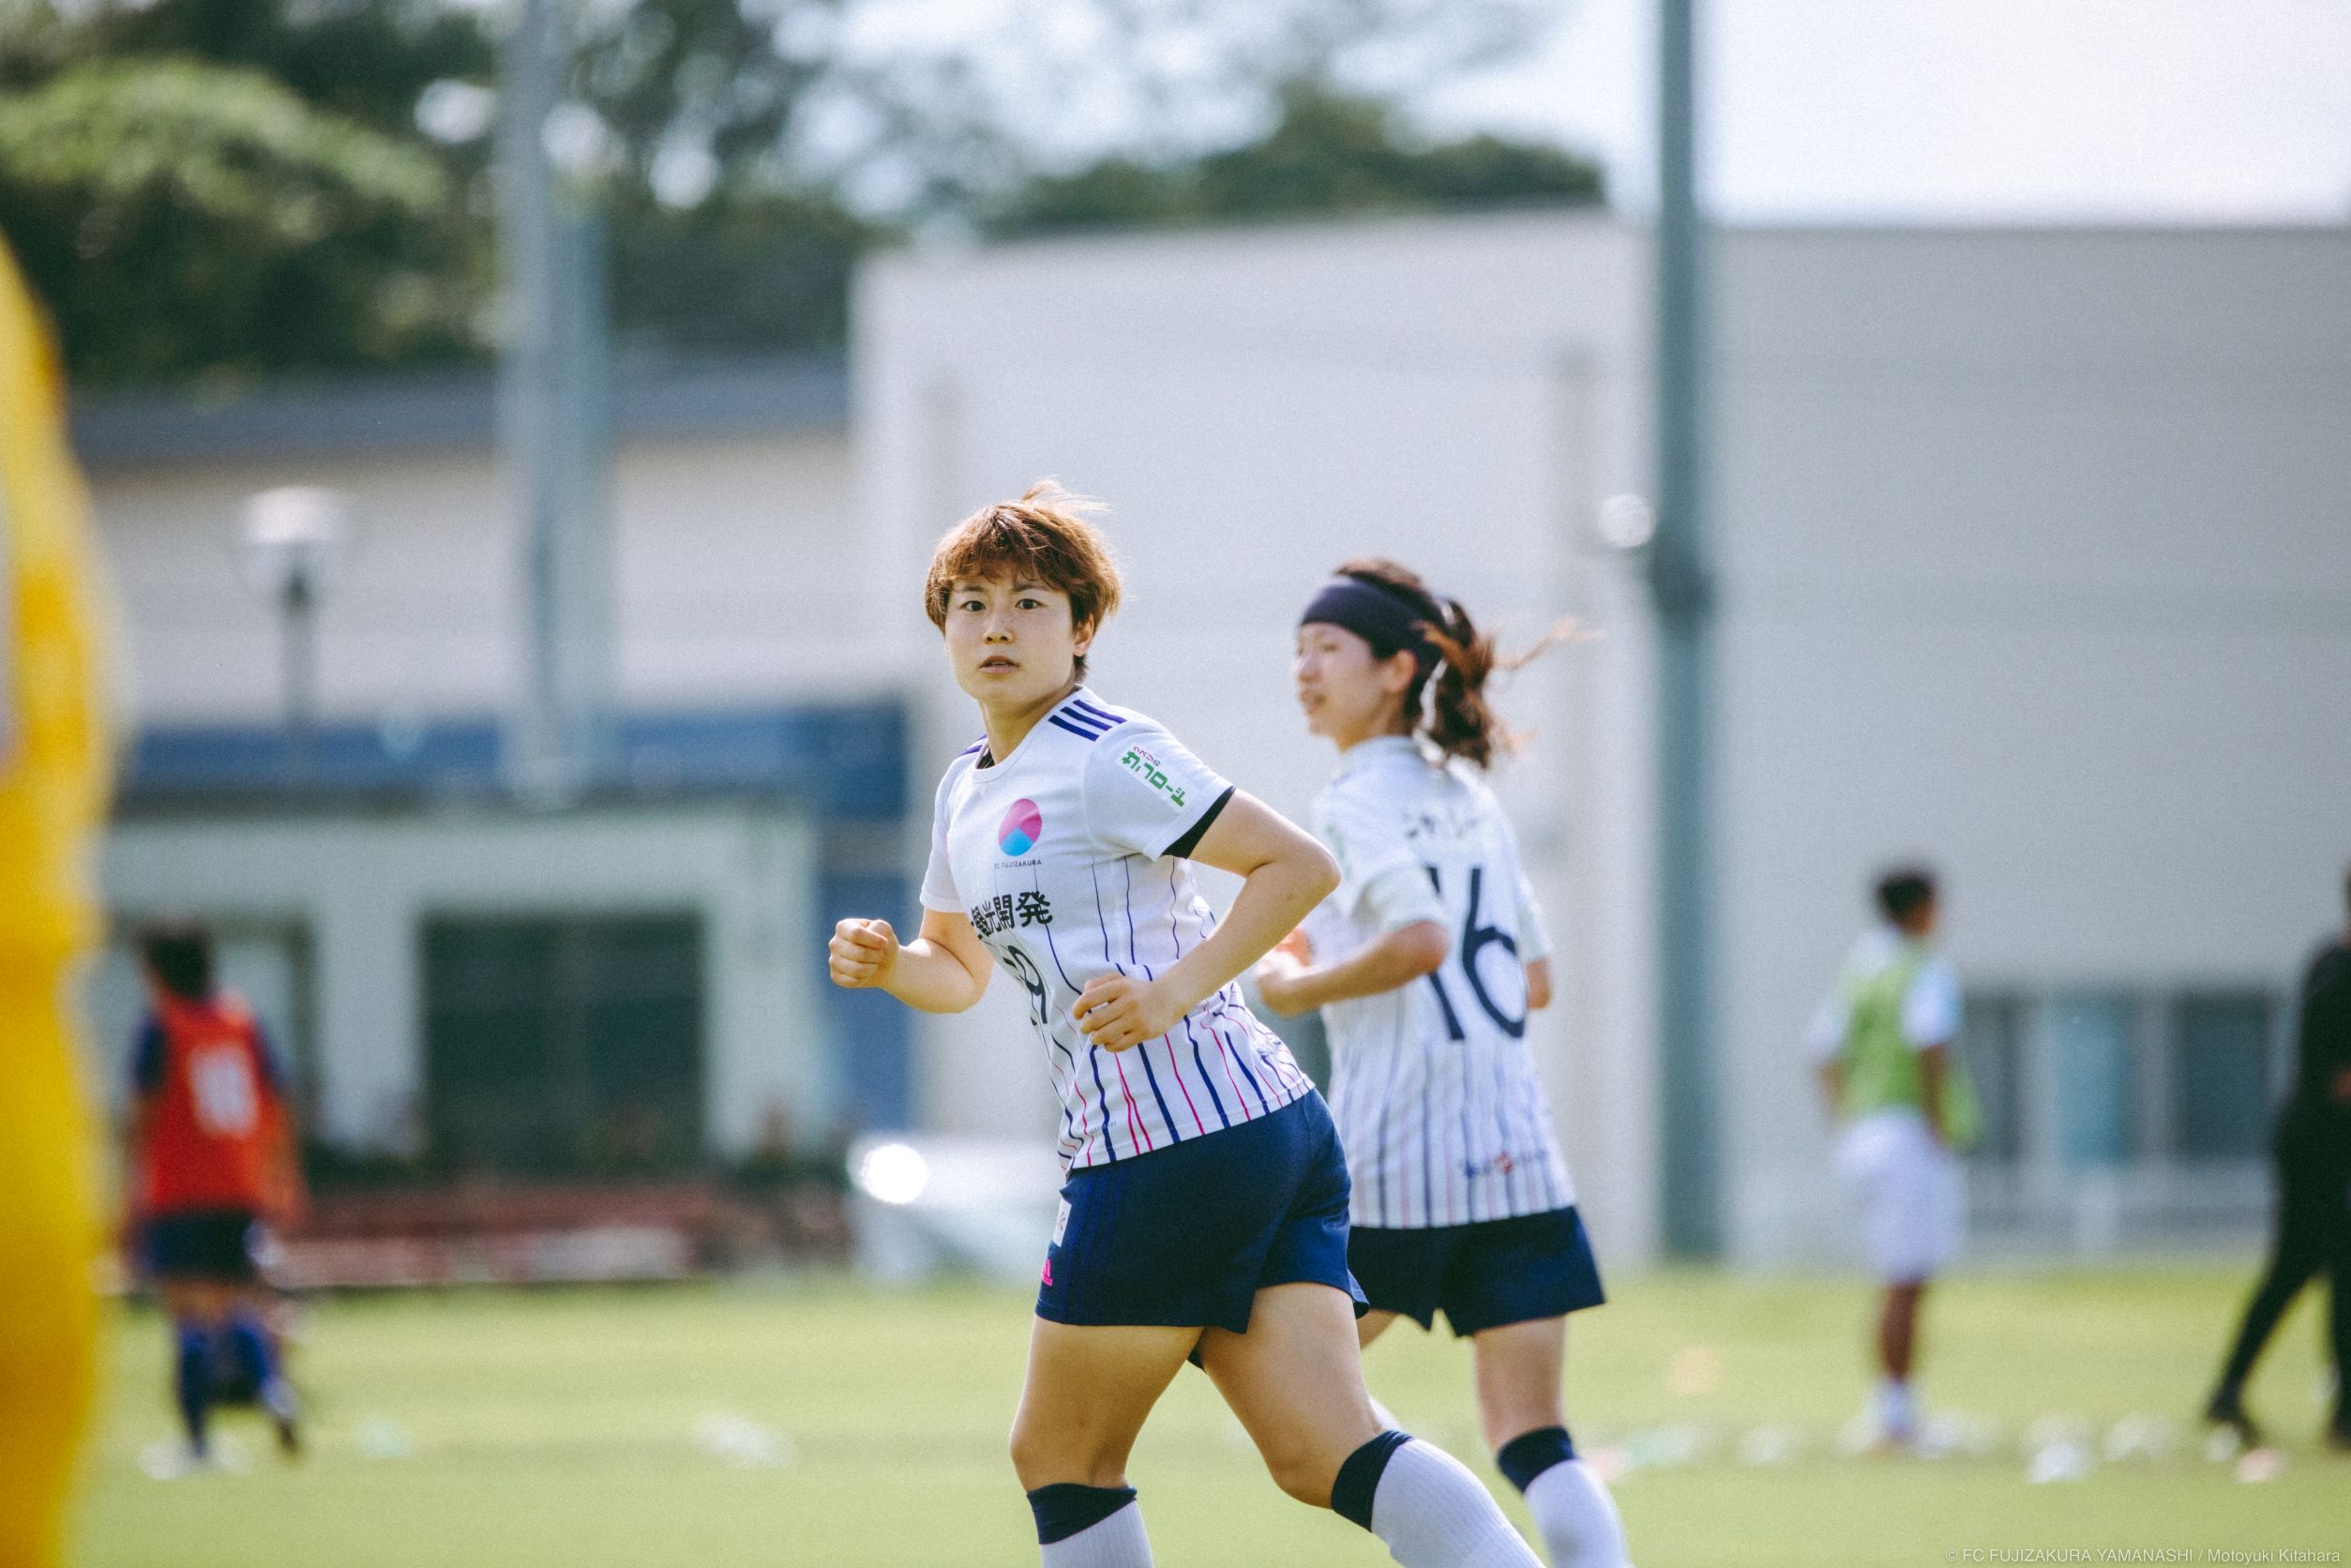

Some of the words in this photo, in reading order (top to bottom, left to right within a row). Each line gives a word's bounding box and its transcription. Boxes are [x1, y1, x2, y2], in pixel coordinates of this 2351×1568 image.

[1122, 750, 1185, 807] サンロード
[1002, 859, 1042, 868] FUJIZAKURA
[971, 891, 1053, 940] 観光開発
[1424, 865, 1529, 1042] 16
